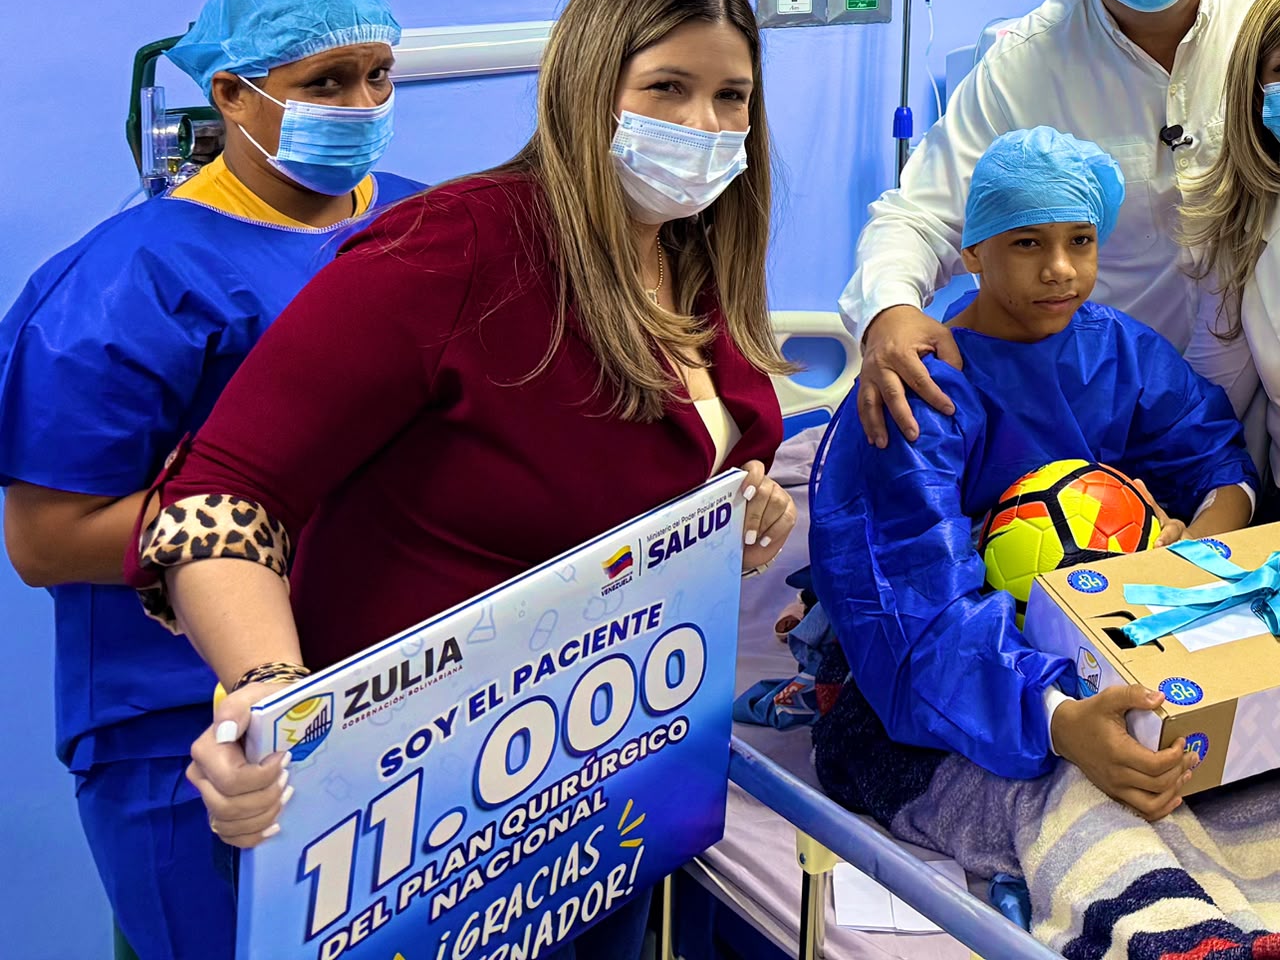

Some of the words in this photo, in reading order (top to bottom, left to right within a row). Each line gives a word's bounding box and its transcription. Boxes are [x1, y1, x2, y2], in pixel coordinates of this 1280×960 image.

[646, 525, 672, 542] Ministerio
[697, 501, 715, 515] Popular
[647, 502, 732, 569] SALUD
[601, 575, 633, 596] VENEZUELA
[342, 695, 405, 730] GOBERNACIÓN
[408, 665, 464, 696] BOLIVARIANA
[343, 636, 464, 720] ZULIA
[380, 705, 459, 778] SOY
[468, 683, 504, 722] EL
[513, 602, 663, 696] PACIENTE
[299, 623, 706, 940] 11.000
[319, 903, 391, 960] DEL
[399, 825, 495, 910] PLAN
[502, 719, 688, 836] QUIRÚRGICO
[431, 791, 608, 920] NACIONAL
